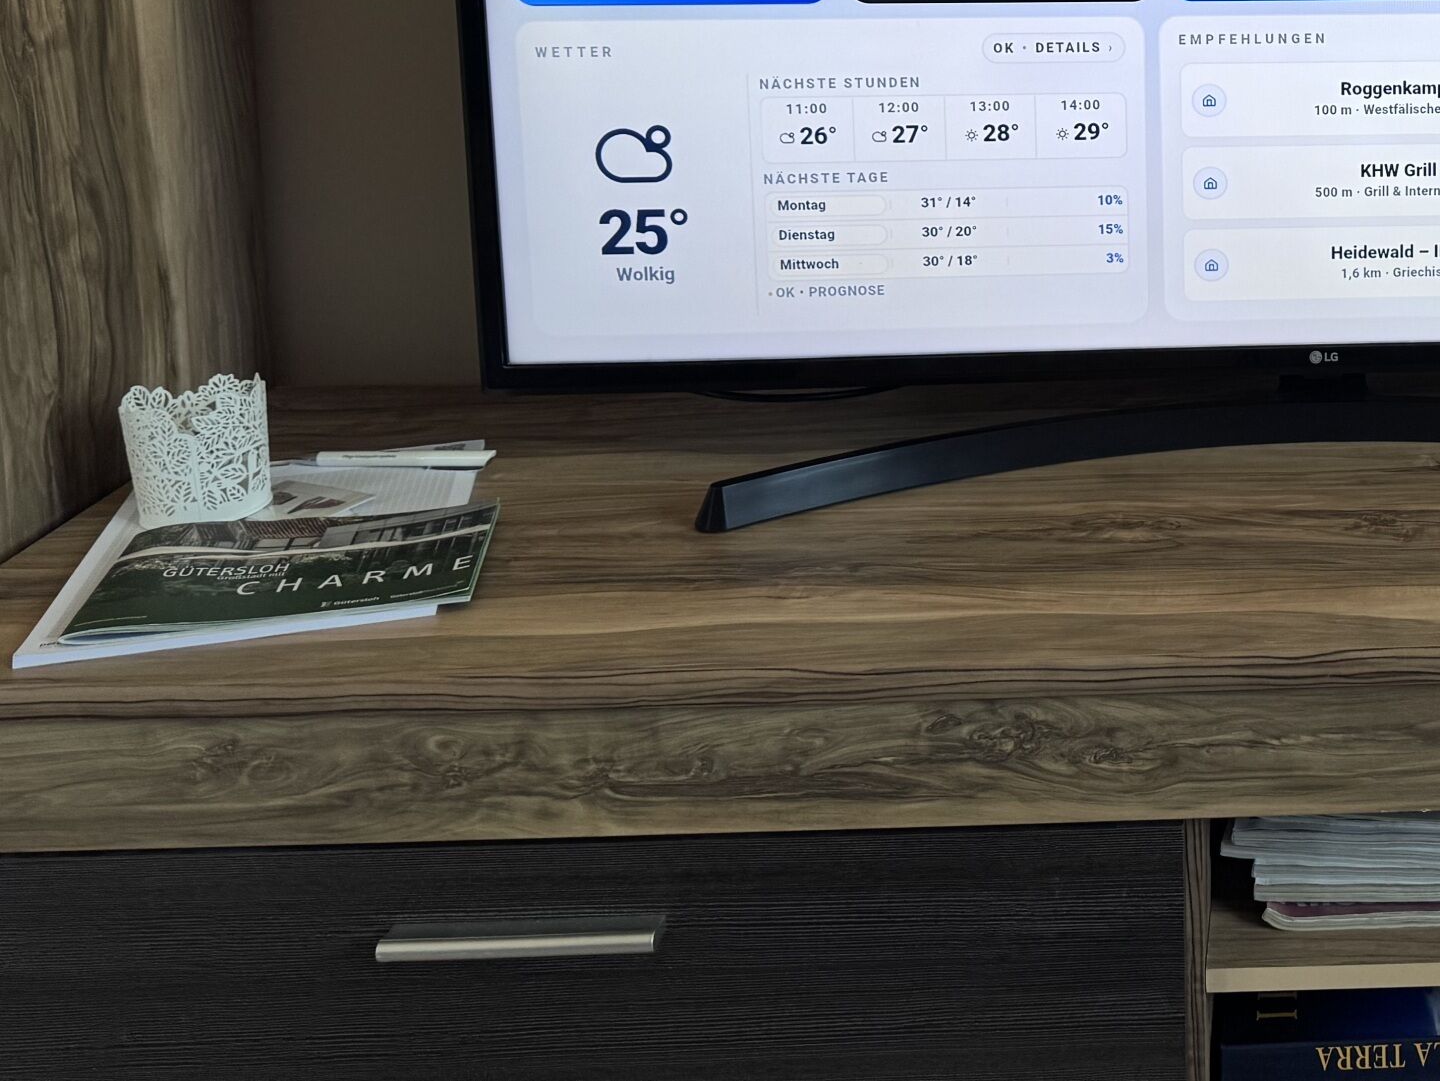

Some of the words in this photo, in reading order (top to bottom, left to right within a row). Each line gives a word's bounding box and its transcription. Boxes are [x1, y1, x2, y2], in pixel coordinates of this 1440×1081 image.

[1179, 33, 1326, 46] EMPFEHLUNGEN
[536, 46, 612, 58] WETTER
[993, 42, 1014, 53] OK
[1035, 42, 1101, 54] DETAILS
[759, 75, 837, 90] NÄCHSTE
[844, 76, 921, 88] STUNDEN
[786, 103, 827, 114] 11:00
[878, 102, 919, 113] 12:00
[970, 101, 1010, 112] 13:00
[1061, 100, 1101, 111] 14:00
[1314, 104, 1337, 115] 100
[1341, 106, 1352, 114] m
[800, 126, 837, 145] 26°
[892, 125, 928, 144] 27°
[983, 124, 1019, 142] 28°
[1073, 122, 1109, 141] 29°
[763, 170, 841, 185] NÄCHSTE
[847, 172, 889, 183] TAGE
[1360, 164, 1399, 178] KHW
[1404, 162, 1437, 178] Grill
[1315, 186, 1338, 198] 500
[1341, 189, 1353, 197] m
[1364, 184, 1389, 197] Grill
[1392, 186, 1402, 196] &
[778, 198, 826, 212] Montag
[921, 196, 943, 209] 31°
[955, 195, 976, 208] 14°
[1097, 194, 1123, 206] 10%
[599, 208, 688, 255] 25°
[778, 228, 836, 243] Dienstag
[922, 225, 944, 238] 30°
[955, 225, 977, 237] 20°
[1098, 223, 1124, 236] 15%
[1331, 243, 1414, 261] Heidewald
[780, 257, 839, 272] Mittwoch
[923, 255, 945, 267] 30°
[957, 254, 978, 267] 18°
[1106, 252, 1124, 264] 3%
[616, 267, 675, 284] Wolkig
[1341, 267, 1360, 280] 1,6
[1363, 266, 1382, 278] km
[776, 287, 794, 299] OK
[808, 284, 885, 298] PROGNOSE
[1324, 352, 1338, 362] LG
[162, 562, 290, 578] GÜTERSLOH
[236, 554, 474, 596] CHARME
[1315, 1043, 1405, 1071] TERRA
